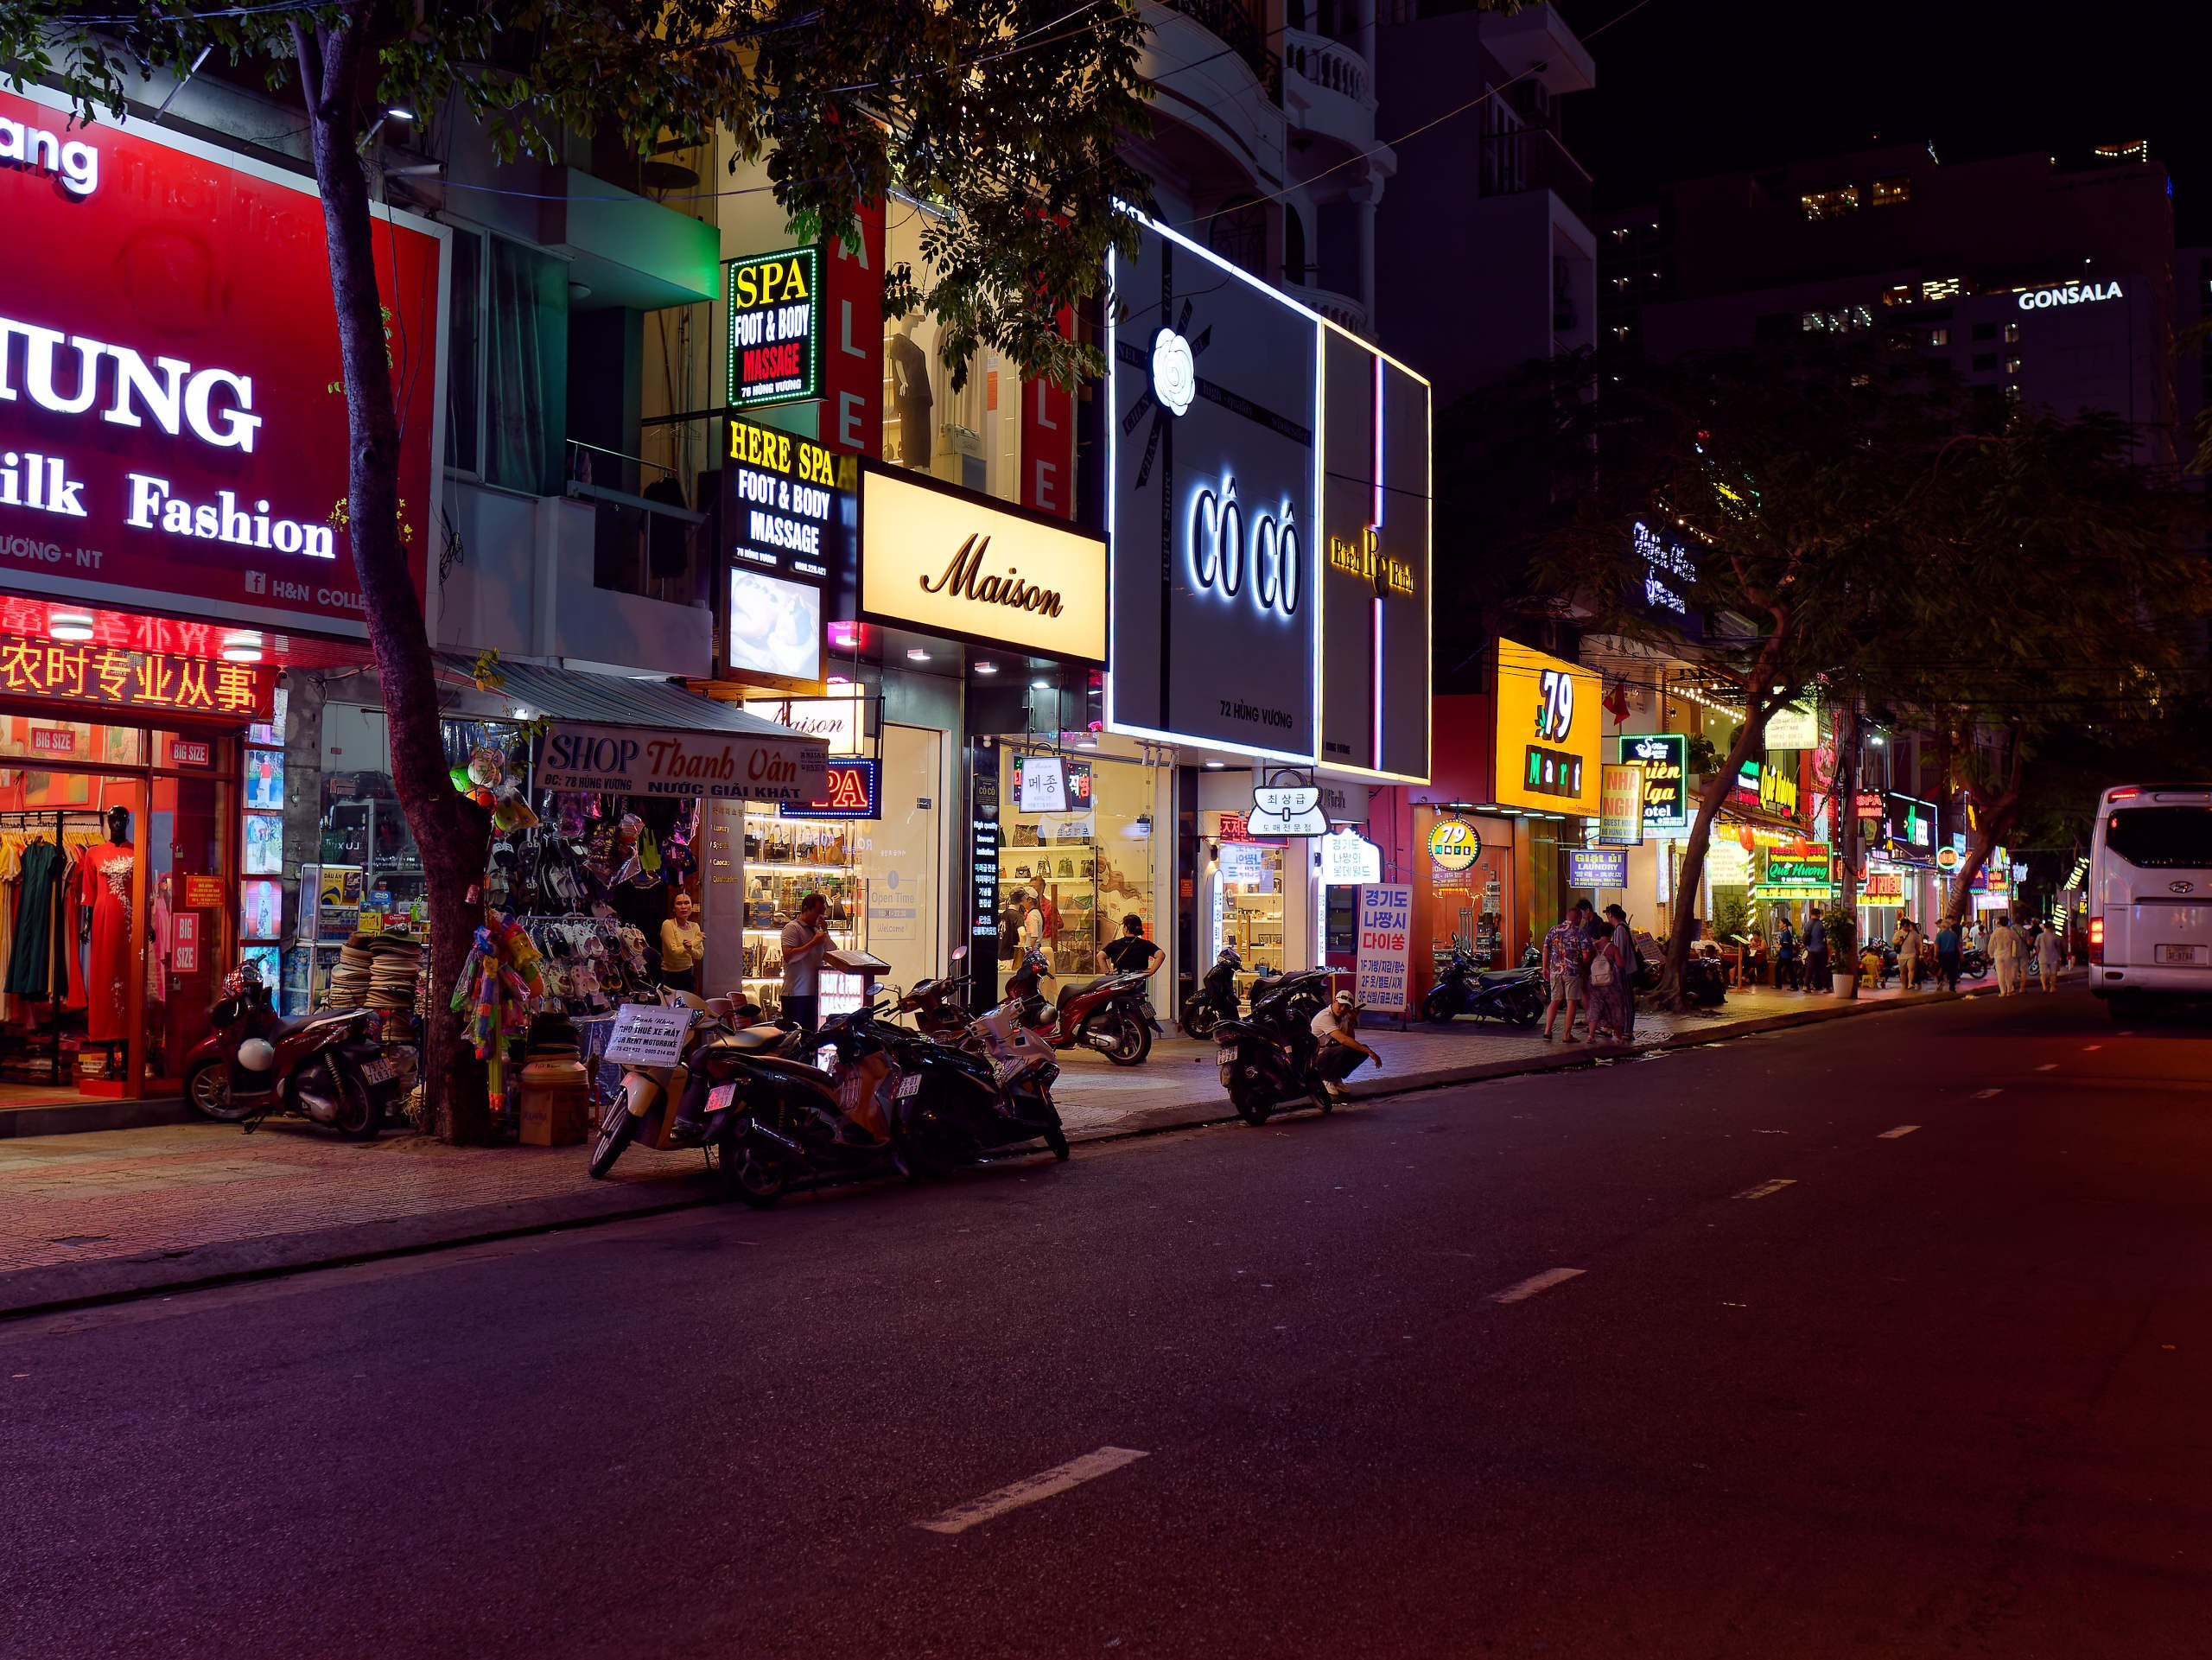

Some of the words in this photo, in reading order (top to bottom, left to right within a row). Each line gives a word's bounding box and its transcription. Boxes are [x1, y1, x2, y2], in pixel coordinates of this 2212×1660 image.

[0, 117, 98, 195] ang
[737, 258, 808, 308] SPA
[2018, 281, 2123, 310] GONSALA
[734, 312, 764, 347] FOOT
[766, 310, 776, 341] &
[778, 304, 810, 340] BODY
[744, 343, 800, 382] MASSAGE
[730, 420, 791, 474] HERE
[798, 442, 835, 487] SPA
[739, 468, 776, 506] FOOT
[779, 481, 790, 510] &
[793, 484, 830, 520] BODY
[0, 452, 87, 517] ilk
[124, 474, 336, 559] Fashion
[750, 510, 819, 556] MASSAGE
[1189, 476, 1245, 597] CÔ
[1253, 501, 1301, 615] CÔ
[76, 548, 103, 569] NT
[1331, 537, 1361, 573] Rich
[1389, 559, 1415, 594] Rich
[919, 533, 1064, 618] Maison
[272, 580, 309, 601] H&N
[1220, 699, 1231, 717] 72
[1233, 698, 1259, 722] HÙNG
[1262, 707, 1293, 729] VƯƠNG
[1542, 669, 1574, 742] 79
[35, 730, 54, 749] BIG
[54, 732, 72, 751] SIZE
[173, 743, 188, 760] BIG
[189, 745, 206, 763] SIZE
[548, 734, 639, 773] SHOP
[648, 738, 734, 781] Thanh
[1529, 751, 1581, 792] Mart
[1626, 760, 1681, 779] hiên
[565, 776, 577, 787] 78
[579, 775, 602, 790] HÙNG
[648, 780, 704, 795] NƯỚC
[710, 782, 749, 797] GIẢI
[810, 770, 868, 807] PA
[1028, 774, 1058, 793] 메종
[1268, 793, 1306, 805] 최상급
[1856, 795, 1882, 806] SPA
[1263, 824, 1312, 832] 도매전문점
[1441, 825, 1466, 843] 79
[871, 892, 893, 906] Open
[895, 892, 914, 904] Time
[1365, 890, 1407, 907] 경기도
[179, 917, 193, 939] BIG
[1364, 911, 1407, 930] 나짱시
[176, 947, 194, 969] SIZE
[1362, 976, 1370, 988] 2F
[643, 1039, 677, 1048] MOTORBIKE
